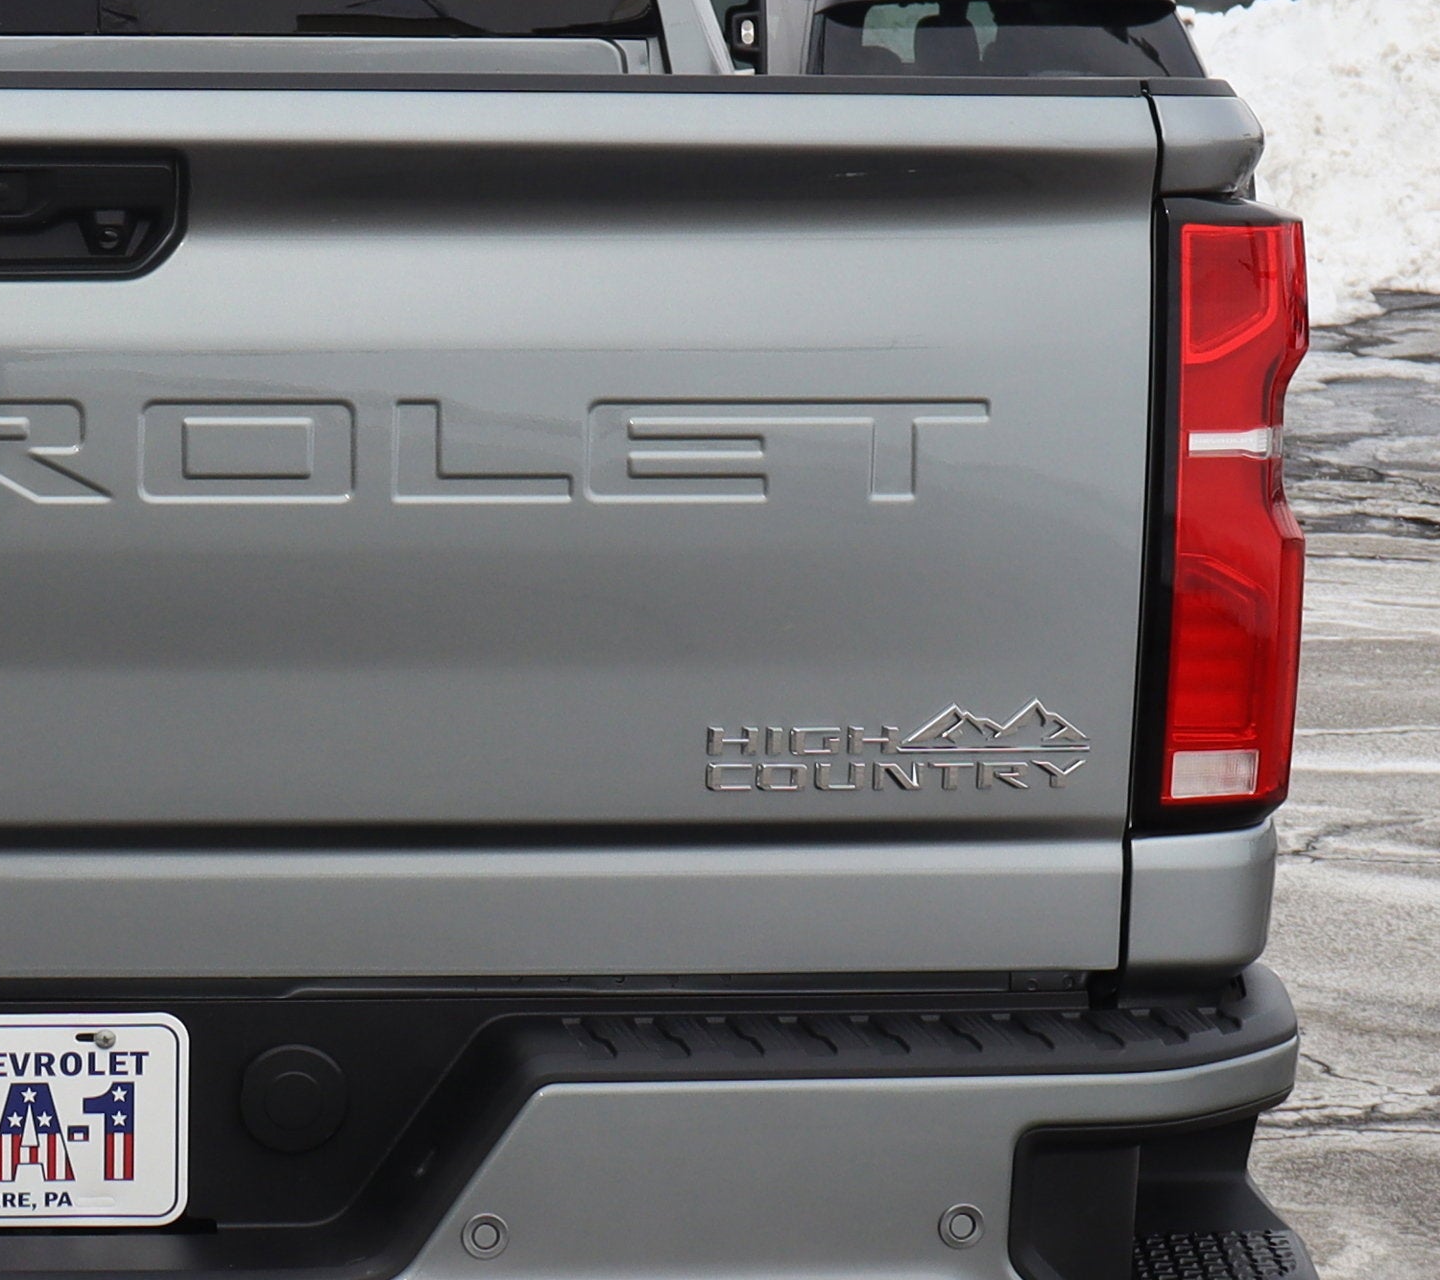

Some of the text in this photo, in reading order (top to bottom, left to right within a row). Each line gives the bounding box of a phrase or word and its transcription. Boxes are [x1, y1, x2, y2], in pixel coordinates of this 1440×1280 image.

[707, 725, 900, 756] HIGH
[706, 759, 1087, 791] COUNTRY
[44, 1192, 73, 1208] PA
